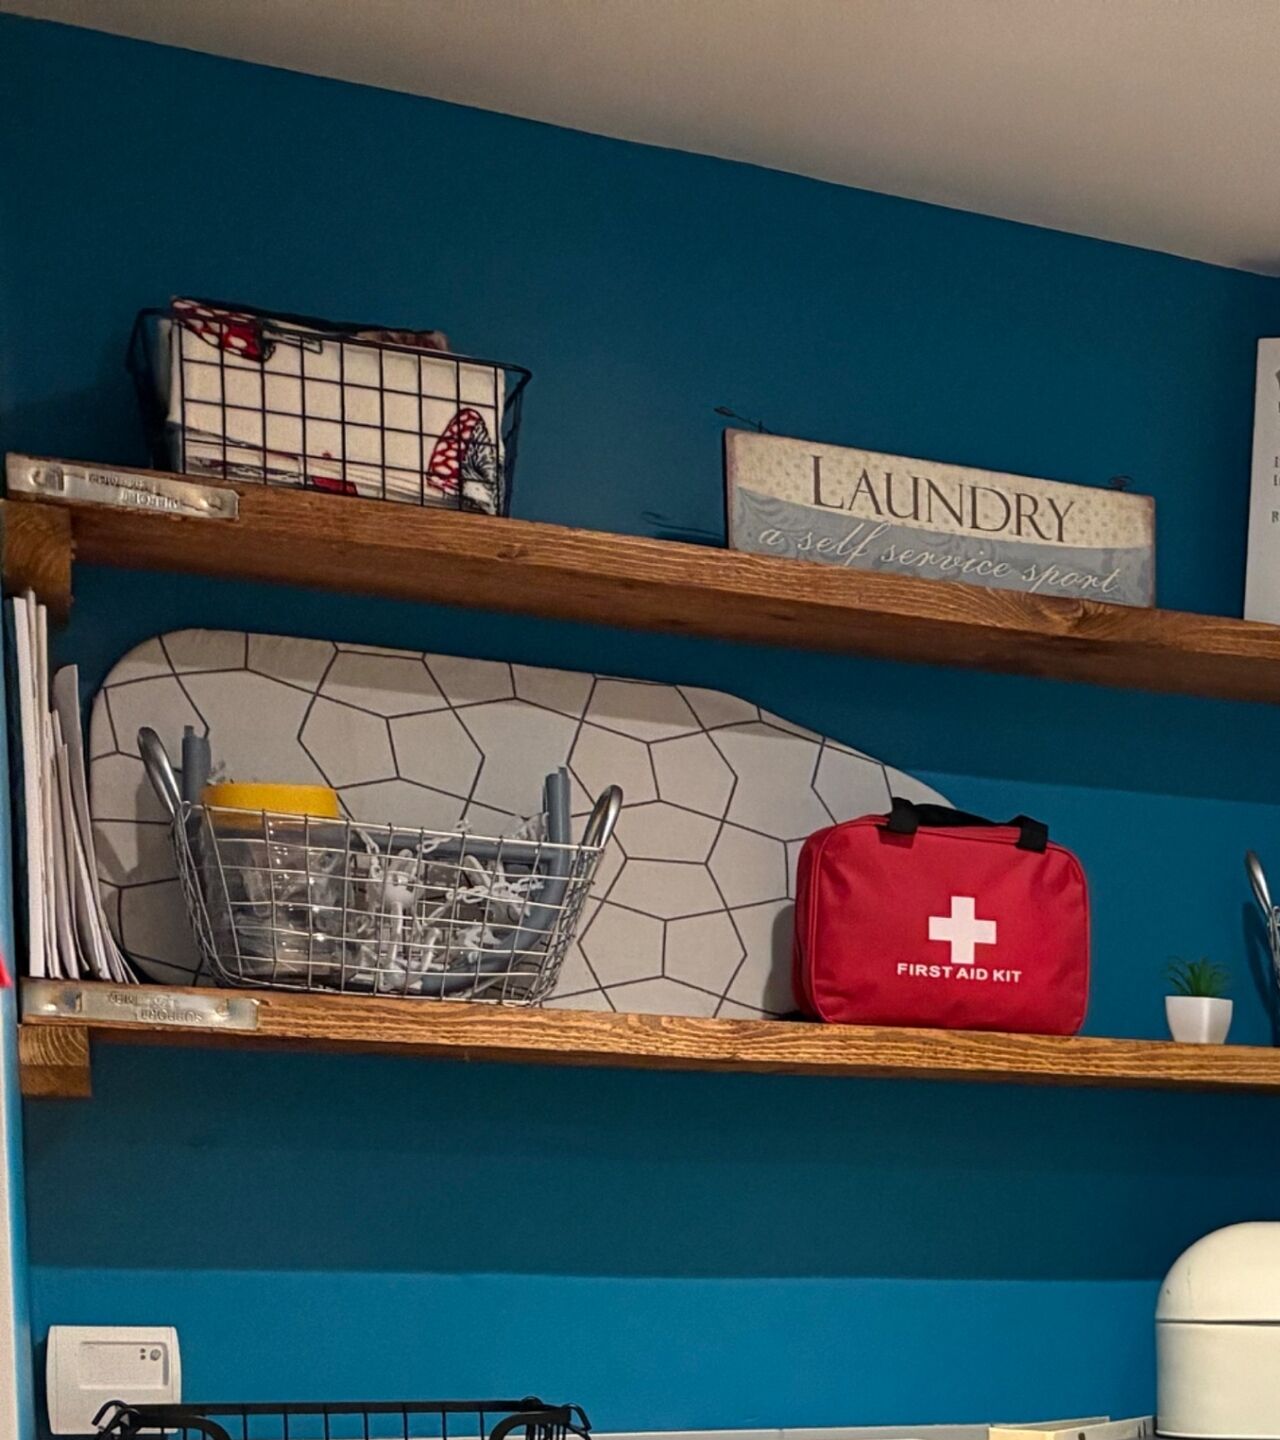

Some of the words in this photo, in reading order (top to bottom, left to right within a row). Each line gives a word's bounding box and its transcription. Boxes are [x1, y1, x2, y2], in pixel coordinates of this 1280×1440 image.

[810, 455, 1076, 543] LAUNDRY
[757, 527, 786, 547] a
[797, 521, 890, 568] self
[880, 541, 1015, 579] service
[897, 963, 953, 979] FIRST
[956, 967, 989, 982] AID
[993, 969, 1022, 983] KIT
